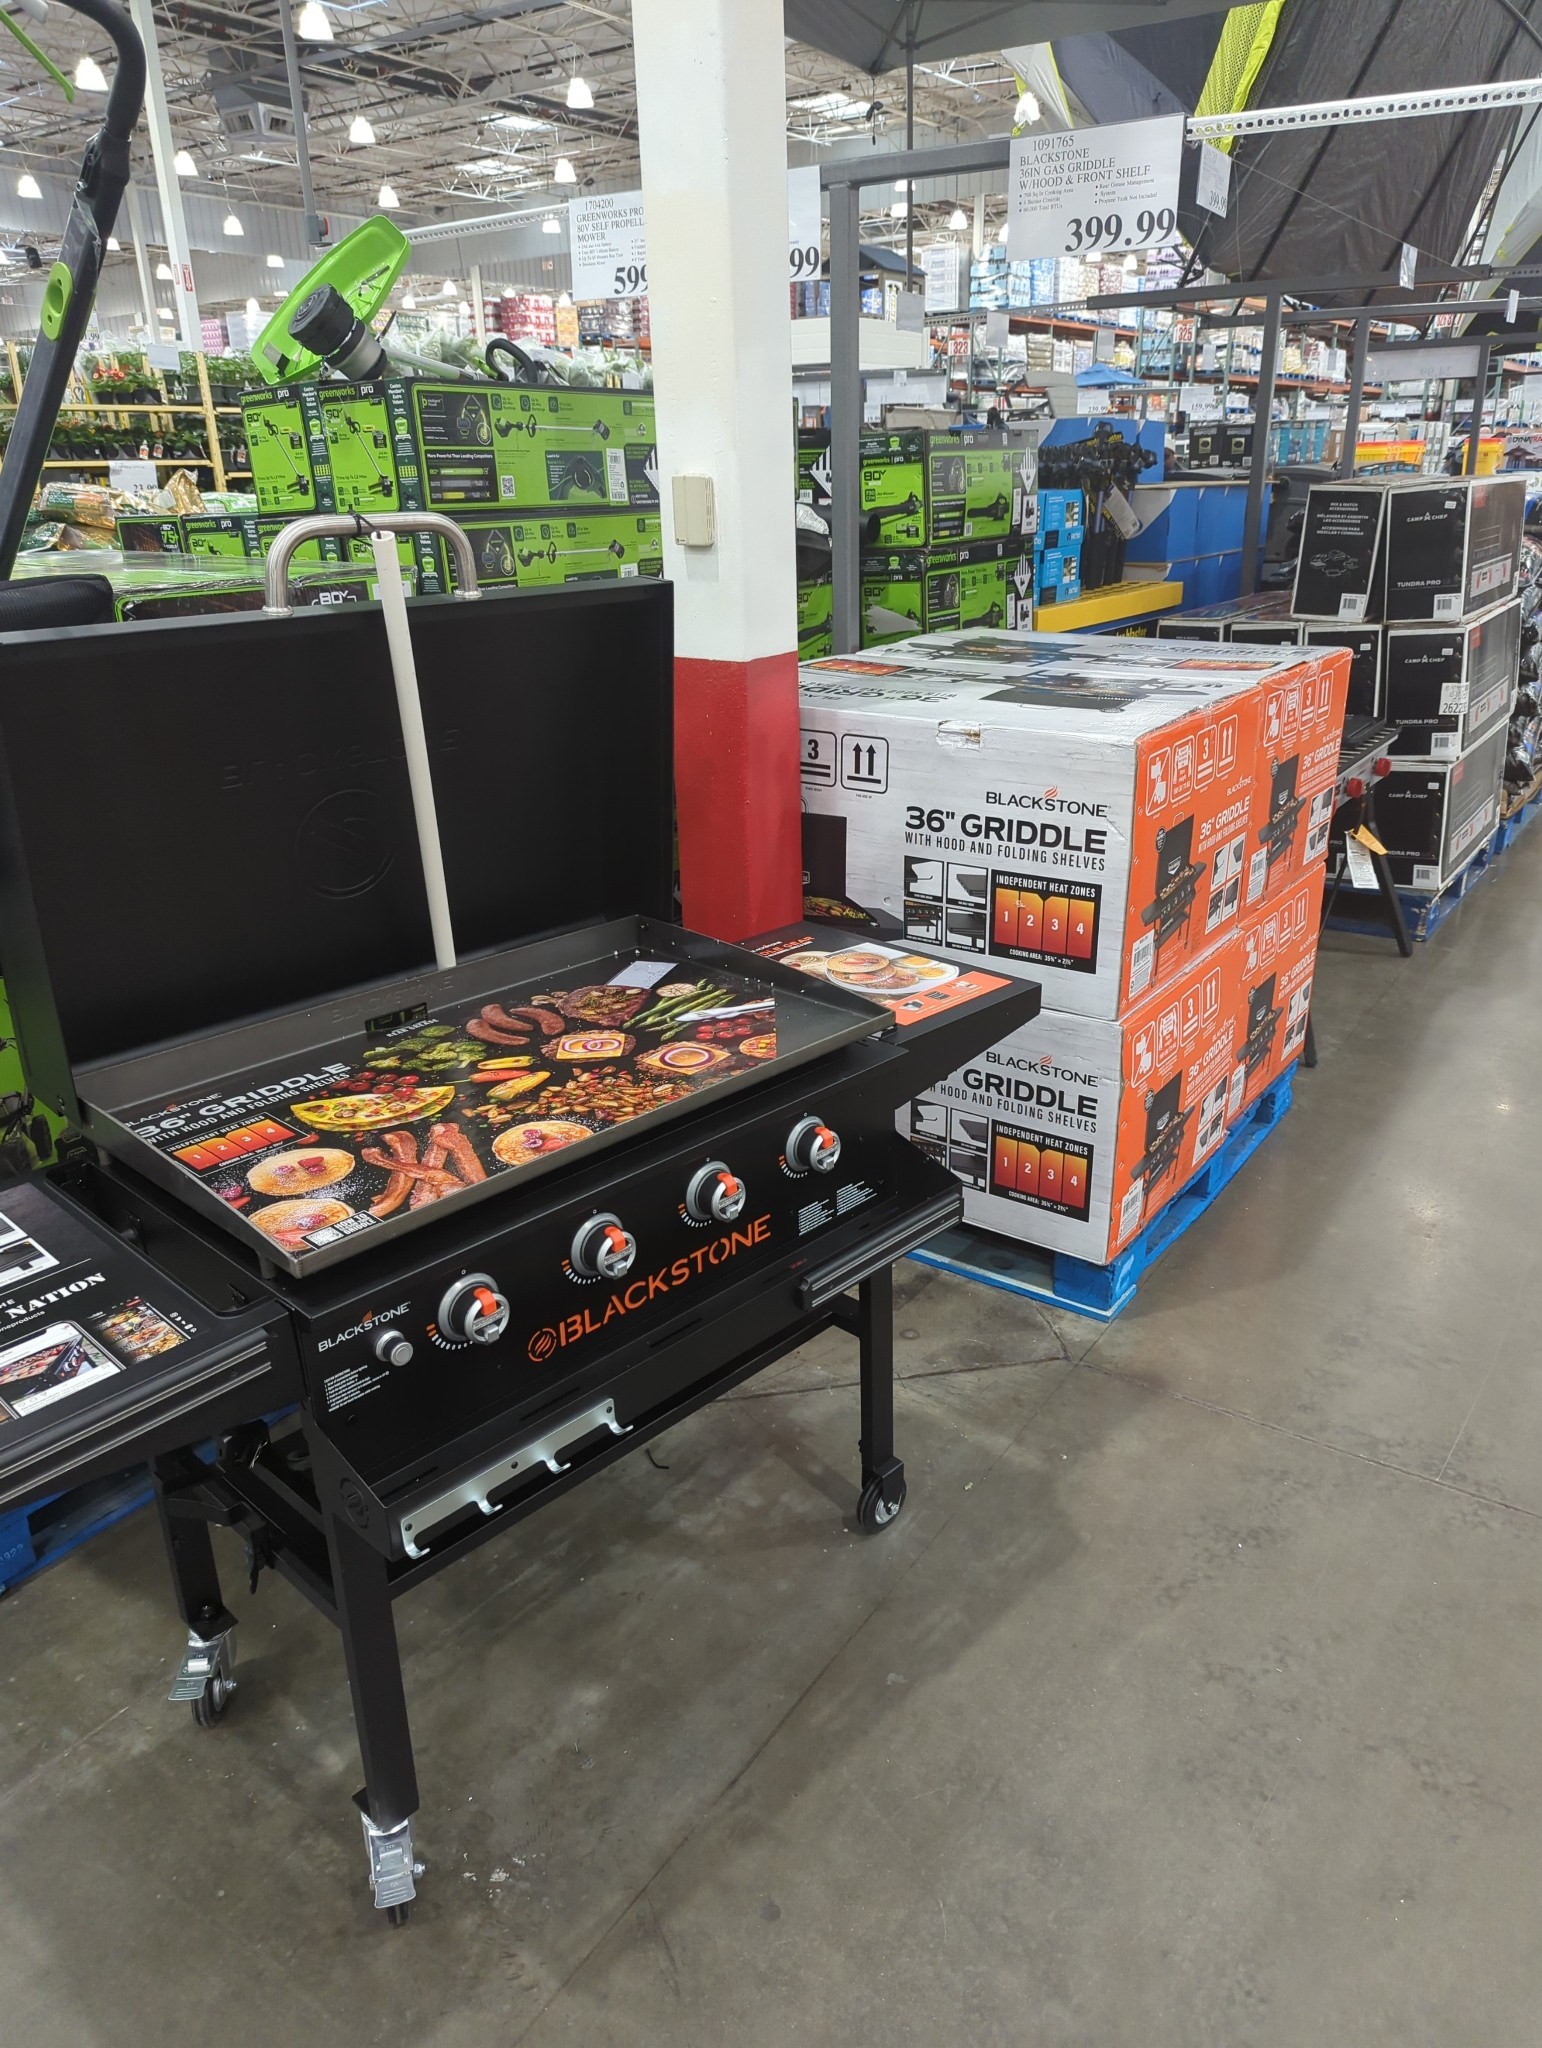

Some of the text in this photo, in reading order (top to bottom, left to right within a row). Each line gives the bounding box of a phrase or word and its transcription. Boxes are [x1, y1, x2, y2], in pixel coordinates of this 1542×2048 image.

[1033, 135, 1075, 151] 1091765
[1020, 148, 1090, 166] BLACKSTONE
[1020, 157, 1116, 179] 36IN GAS GRIDDLE
[1019, 165, 1150, 191] W/HOOD & FRONT SHELF
[577, 207, 644, 223] GREENWORKS PRO
[585, 198, 614, 211] 1704200
[577, 223, 590, 233] 80V
[592, 220, 609, 232] SELF
[578, 232, 606, 243] MOWER
[1065, 208, 1175, 252] 399.99
[789, 246, 820, 279] 99
[240, 388, 290, 403] greenworks pro
[319, 384, 374, 400] greenworks pro
[929, 435, 974, 448] greenworks pro
[863, 457, 890, 466] greenworks
[864, 470, 886, 481] 80V
[186, 520, 232, 531] greenworks pro
[926, 550, 969, 567] greenworks pro
[319, 590, 348, 605] 80V
[864, 586, 886, 597] 80V
[1306, 686, 1312, 706] 3
[807, 738, 819, 760] 3
[1203, 737, 1209, 760] 3
[1314, 737, 1341, 763] GRIDDLE
[1226, 776, 1252, 797] BLACKSTONE
[986, 791, 1109, 818] BLACKSTONE
[1200, 795, 1250, 840] 36" GRIDDLE
[905, 806, 1107, 855] 36" GRIDDLE
[905, 831, 1105, 872] WITH HOOD AND FOLDING SHELVES
[996, 874, 1096, 898] INDEPENDENT HEAT ZONES
[1004, 911, 1084, 935] 1 2 3 4
[1283, 911, 1289, 929] 3
[1009, 949, 1043, 961] COOKING AREA:
[1187, 998, 1194, 1019] 3
[1203, 1025, 1234, 1066] GRIDDLE
[986, 1051, 1099, 1088] BLACKSTONE
[134, 1062, 351, 1139] 36" GRIDDLE
[183, 1116, 218, 1133] HOOD
[220, 1106, 246, 1120] AND
[249, 1089, 301, 1110] FOLDING
[300, 1072, 350, 1093] SHELVES
[963, 1068, 1098, 1119] GRIDDLE
[940, 1084, 1097, 1134] HOOD AND FOLDING SHELVES
[166, 1114, 266, 1153] INDEPENDENT HEAT ZONES
[192, 1127, 276, 1161] 1 2 3 4
[996, 1124, 1089, 1156] INDEPENDENT HEAT ZONES
[1003, 1157, 1078, 1187] 1 2 3 4
[1008, 1190, 1026, 1201] COOKING
[558, 1214, 771, 1347] BLACKSTONE
[5, 1272, 106, 1319] NATION
[318, 1301, 411, 1352] BLACKSTONE
